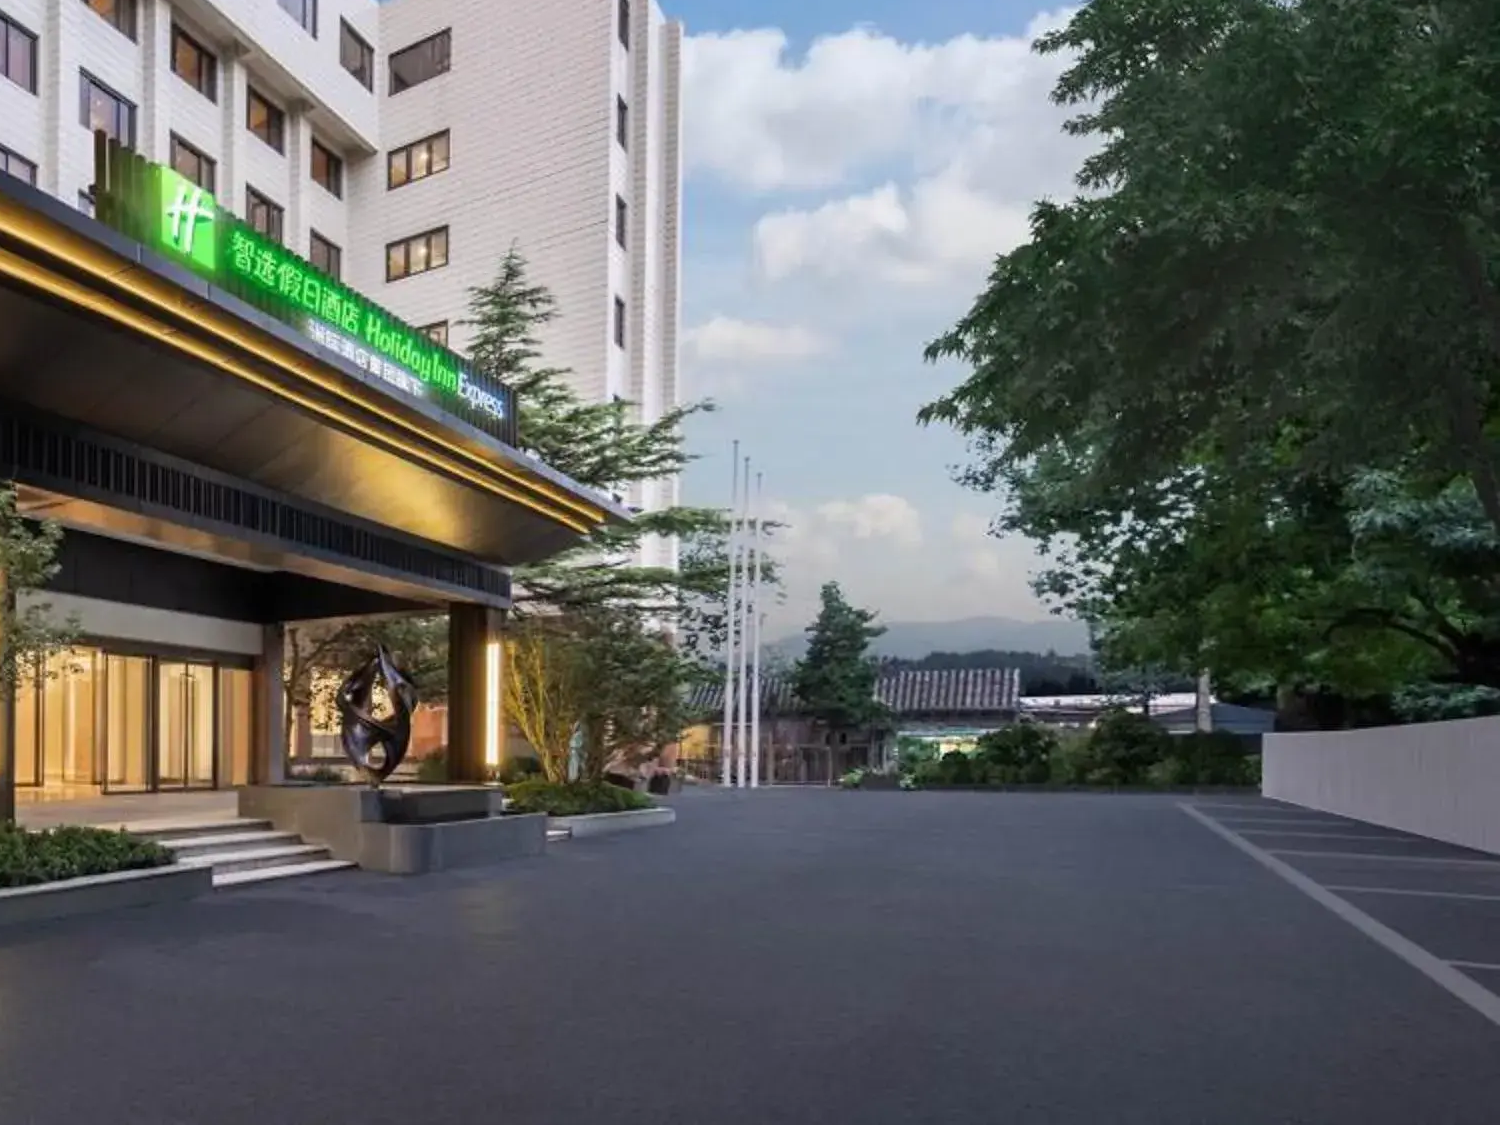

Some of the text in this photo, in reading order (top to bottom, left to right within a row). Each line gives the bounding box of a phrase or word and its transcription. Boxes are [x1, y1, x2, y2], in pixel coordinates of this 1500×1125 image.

[232, 230, 359, 336] 智选假日酒店
[365, 313, 505, 419] Holiday Inn Express
